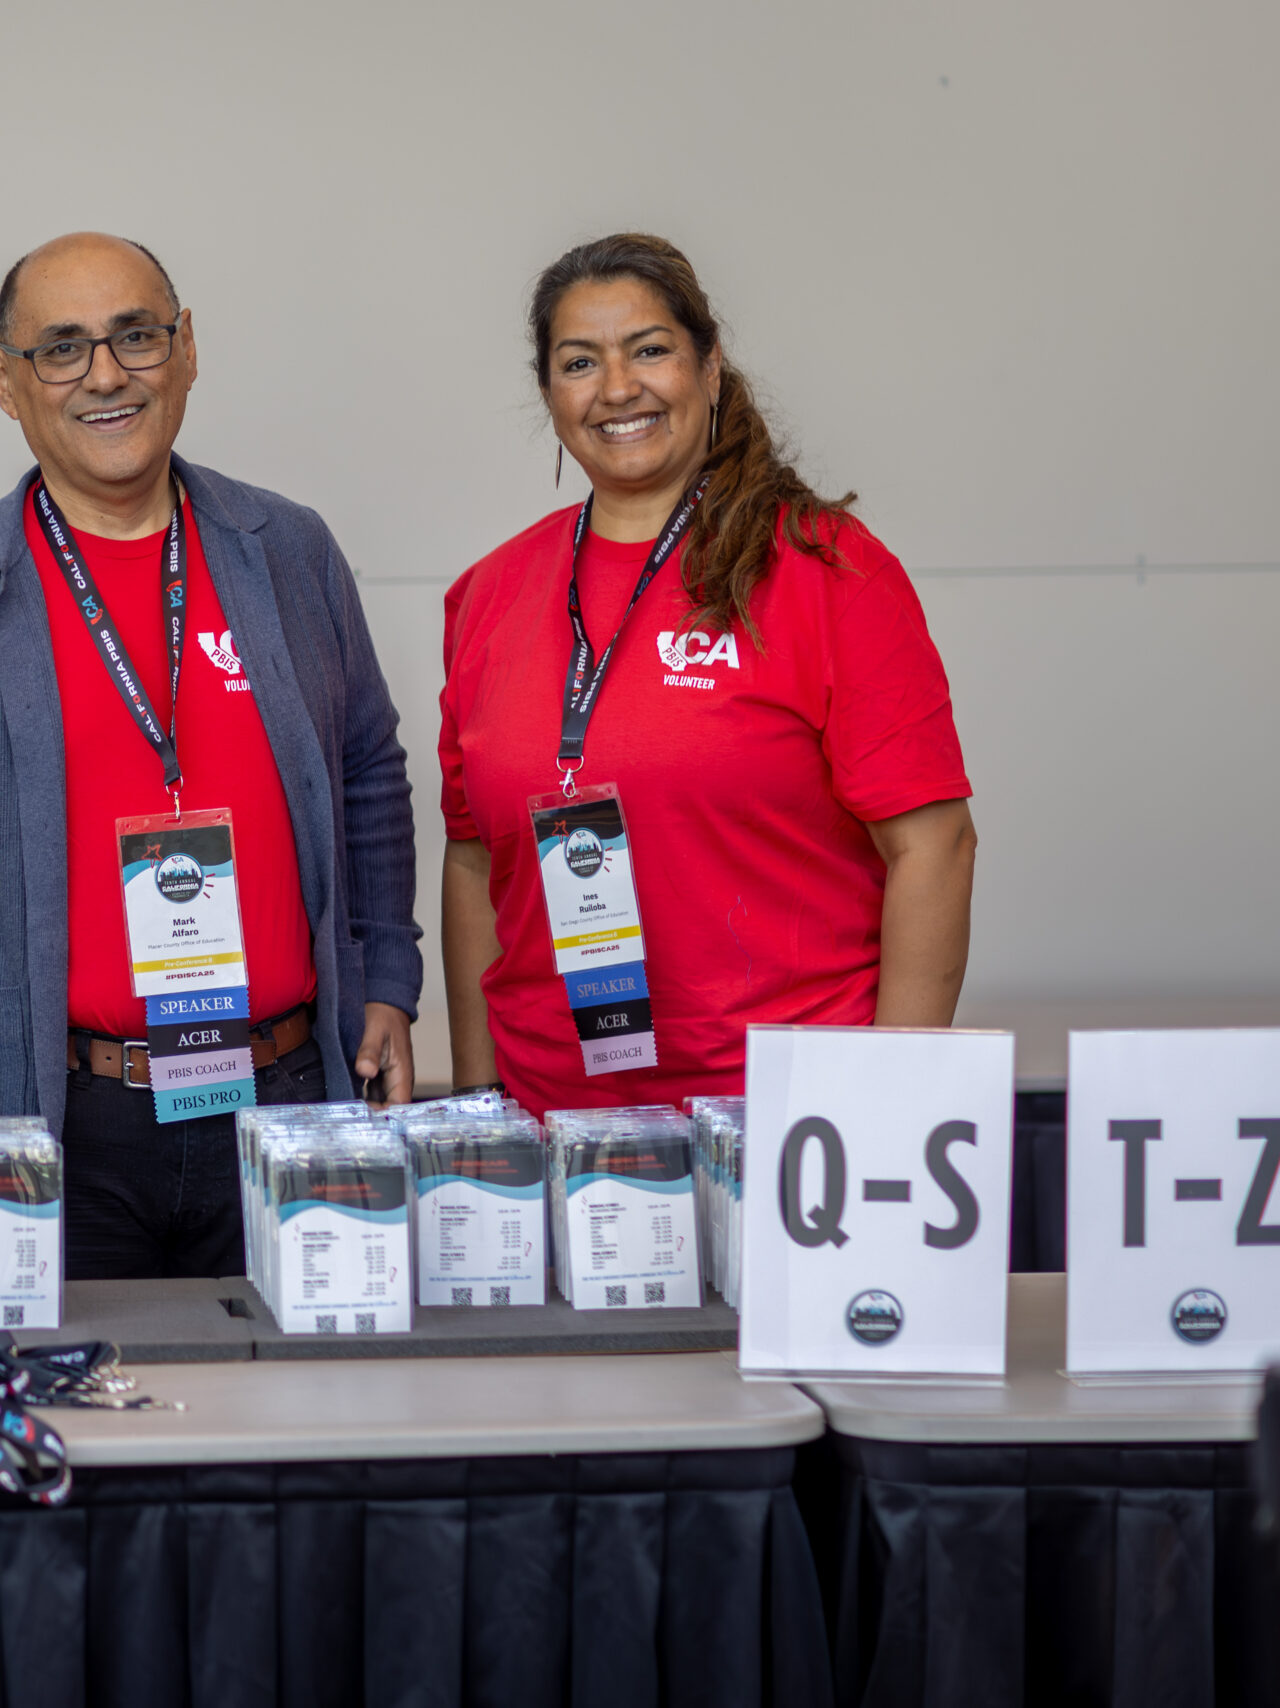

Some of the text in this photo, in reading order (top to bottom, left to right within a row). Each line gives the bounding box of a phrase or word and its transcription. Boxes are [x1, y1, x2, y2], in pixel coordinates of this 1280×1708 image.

[38, 489, 53, 518] PBIS
[170, 541, 178, 573] PBIS
[654, 532, 673, 564] PBIS
[101, 629, 121, 662] PBIS
[211, 649, 235, 670] PBIS
[662, 647, 683, 668] PBIS
[663, 674, 715, 690] VOLUNTEER
[583, 892, 599, 901] Ines
[579, 903, 607, 914] Ruiloba
[173, 917, 196, 926] Mark
[579, 916, 593, 925] County
[172, 928, 199, 938] Alfaro
[148, 942, 162, 950] Placer
[163, 941, 180, 949] County
[581, 944, 620, 956] #PBISCA25
[165, 970, 215, 980] #PBISCA25
[577, 977, 636, 998] SPEAKER
[160, 996, 235, 1015] SPEAKER
[596, 1013, 630, 1030] ACER
[177, 1029, 222, 1047] ACER
[593, 1046, 642, 1064] PBIS COACH
[168, 1060, 237, 1079] PBIS COACH
[172, 1089, 242, 1111] PBIS PRO
